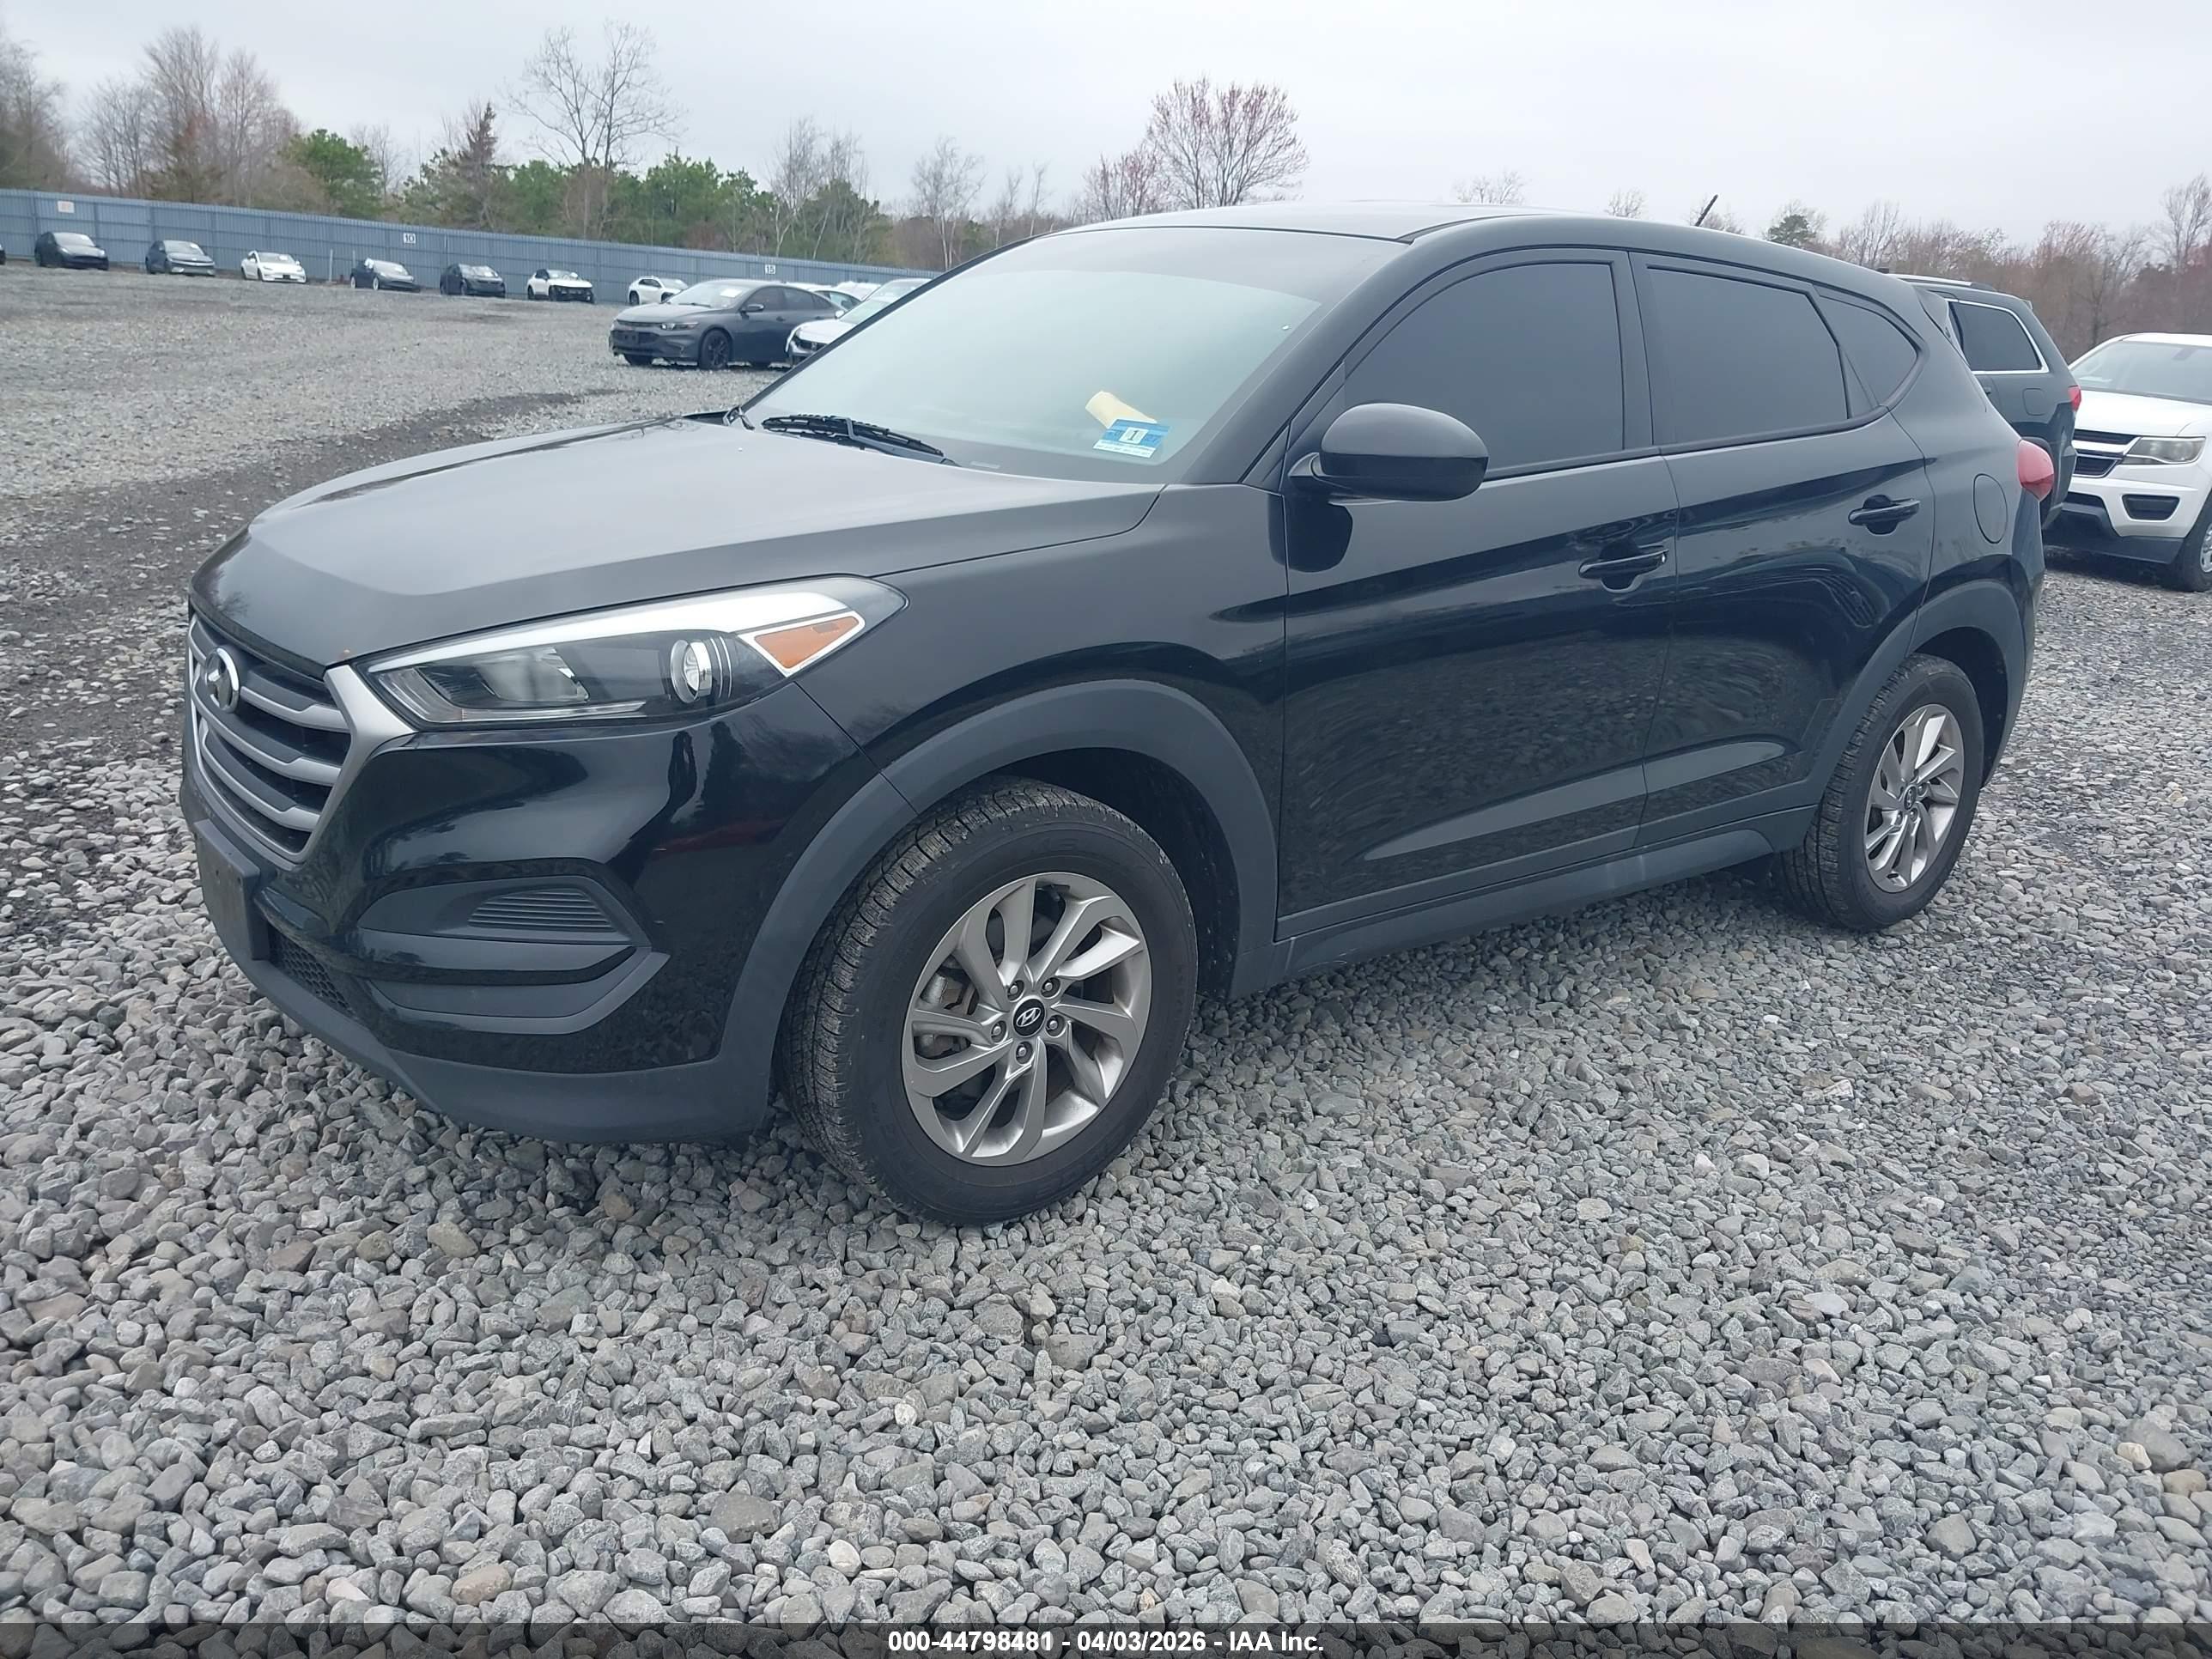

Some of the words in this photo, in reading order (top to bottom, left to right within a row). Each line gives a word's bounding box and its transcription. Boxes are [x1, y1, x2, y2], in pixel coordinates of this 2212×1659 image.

[405, 234, 415, 242] 10
[766, 265, 775, 274] 15
[1127, 429, 1139, 441] 1
